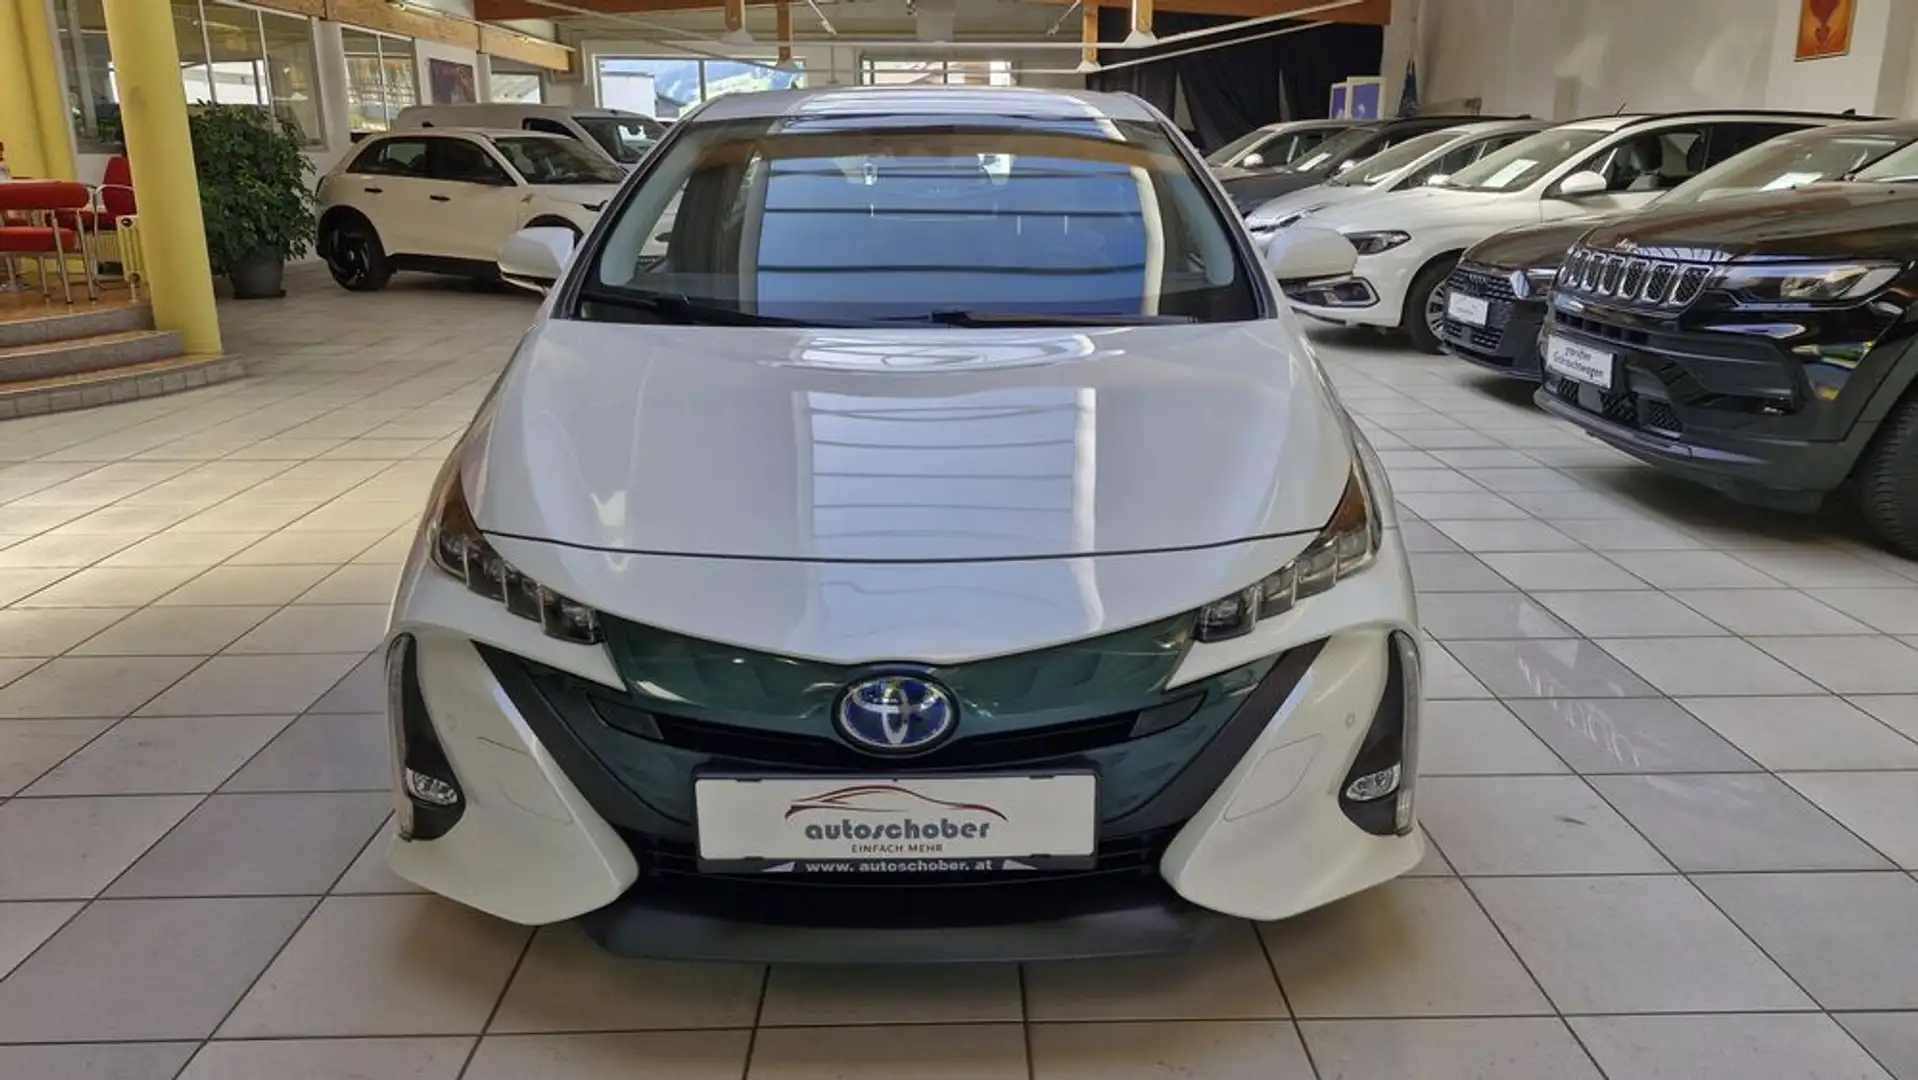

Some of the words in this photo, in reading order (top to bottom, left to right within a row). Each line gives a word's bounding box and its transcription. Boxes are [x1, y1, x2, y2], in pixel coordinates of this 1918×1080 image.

[804, 818, 990, 840] autoschober
[851, 844, 903, 853] EINFACH
[909, 843, 944, 853] MEHR
